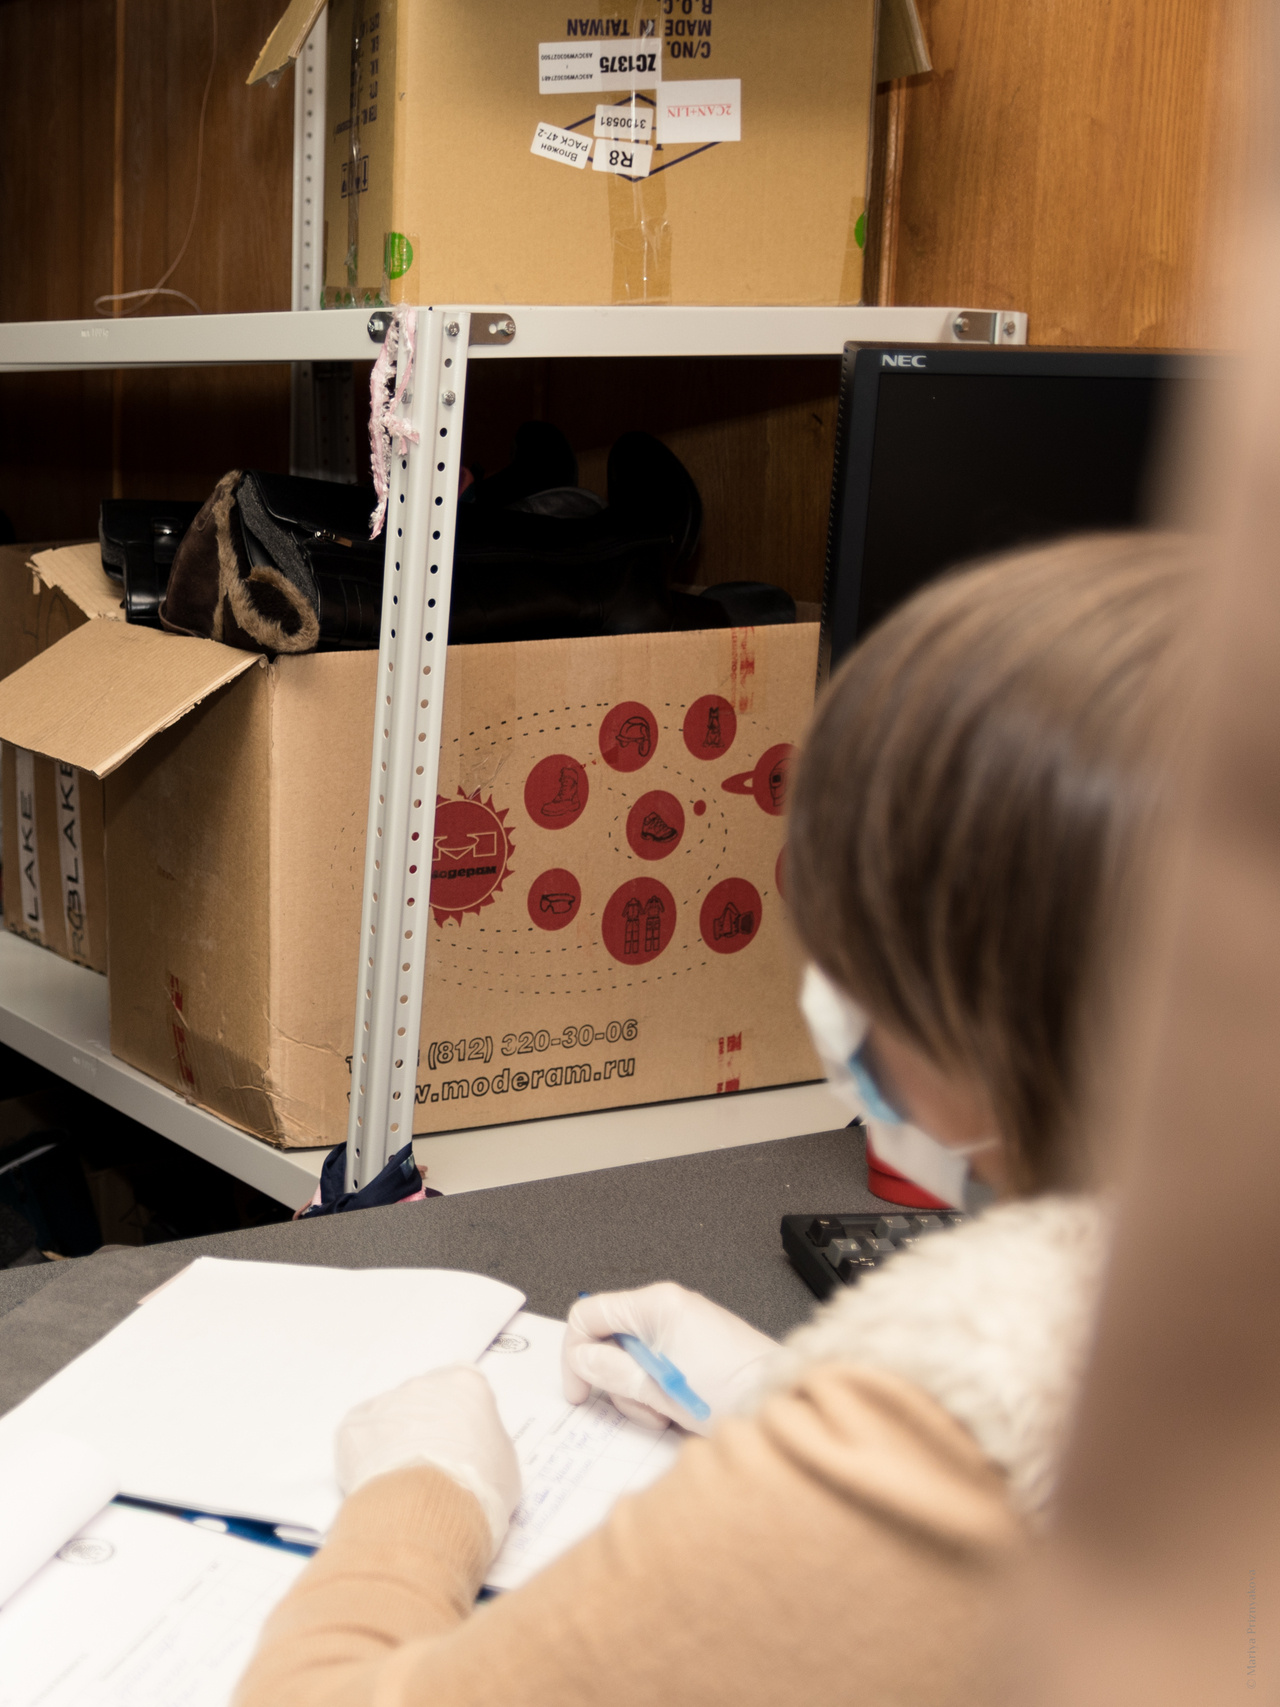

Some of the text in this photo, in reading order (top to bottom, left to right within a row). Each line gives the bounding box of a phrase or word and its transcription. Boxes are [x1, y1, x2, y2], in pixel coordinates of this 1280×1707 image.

[567, 19, 712, 37] MADE IN TAIWAN
[666, 40, 712, 59] C/NO.
[600, 54, 657, 73] ZC1375
[667, 104, 732, 118] 2CAN+LIN
[600, 116, 647, 129] 3100581
[537, 128, 589, 152] PACK 47-2
[540, 143, 578, 162] Вложен
[609, 150, 634, 168] R8
[882, 354, 927, 368] NEC
[427, 1036, 494, 1071] (812)
[500, 1018, 639, 1057] 320-30-06
